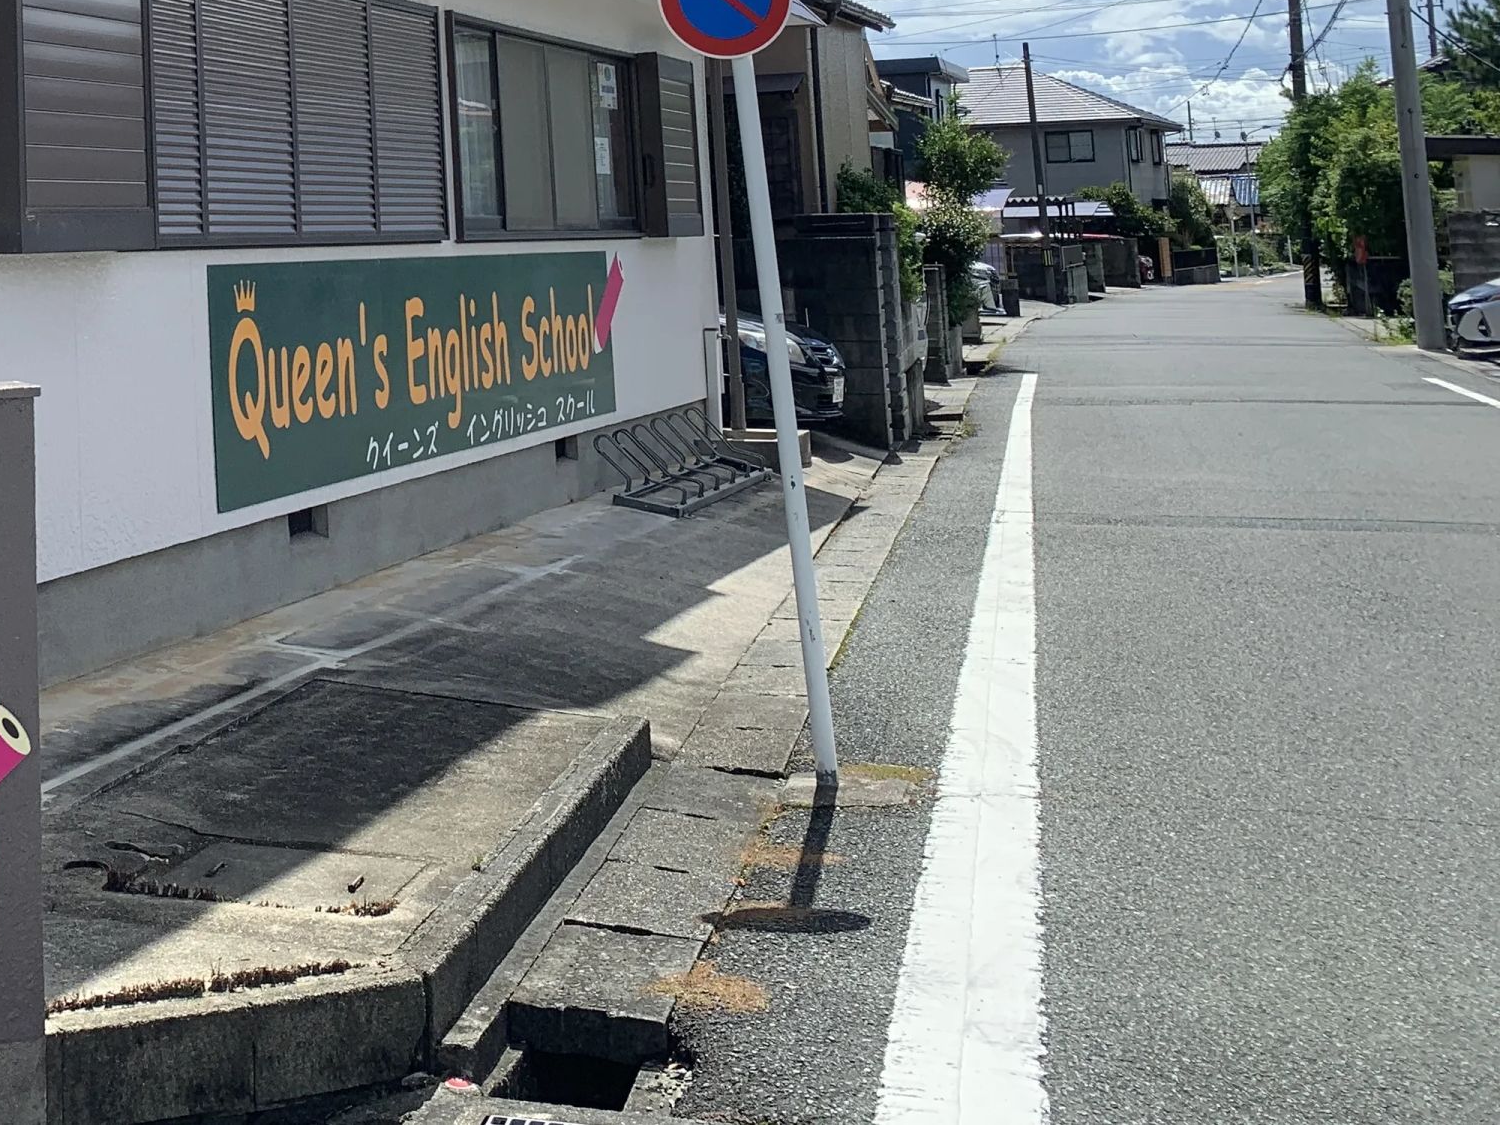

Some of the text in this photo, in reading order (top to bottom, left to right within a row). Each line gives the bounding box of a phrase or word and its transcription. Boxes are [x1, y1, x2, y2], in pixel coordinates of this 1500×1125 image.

[228, 283, 596, 460] Queen's English School
[366, 389, 595, 469] クイーンズ イングリッシュ スクール
